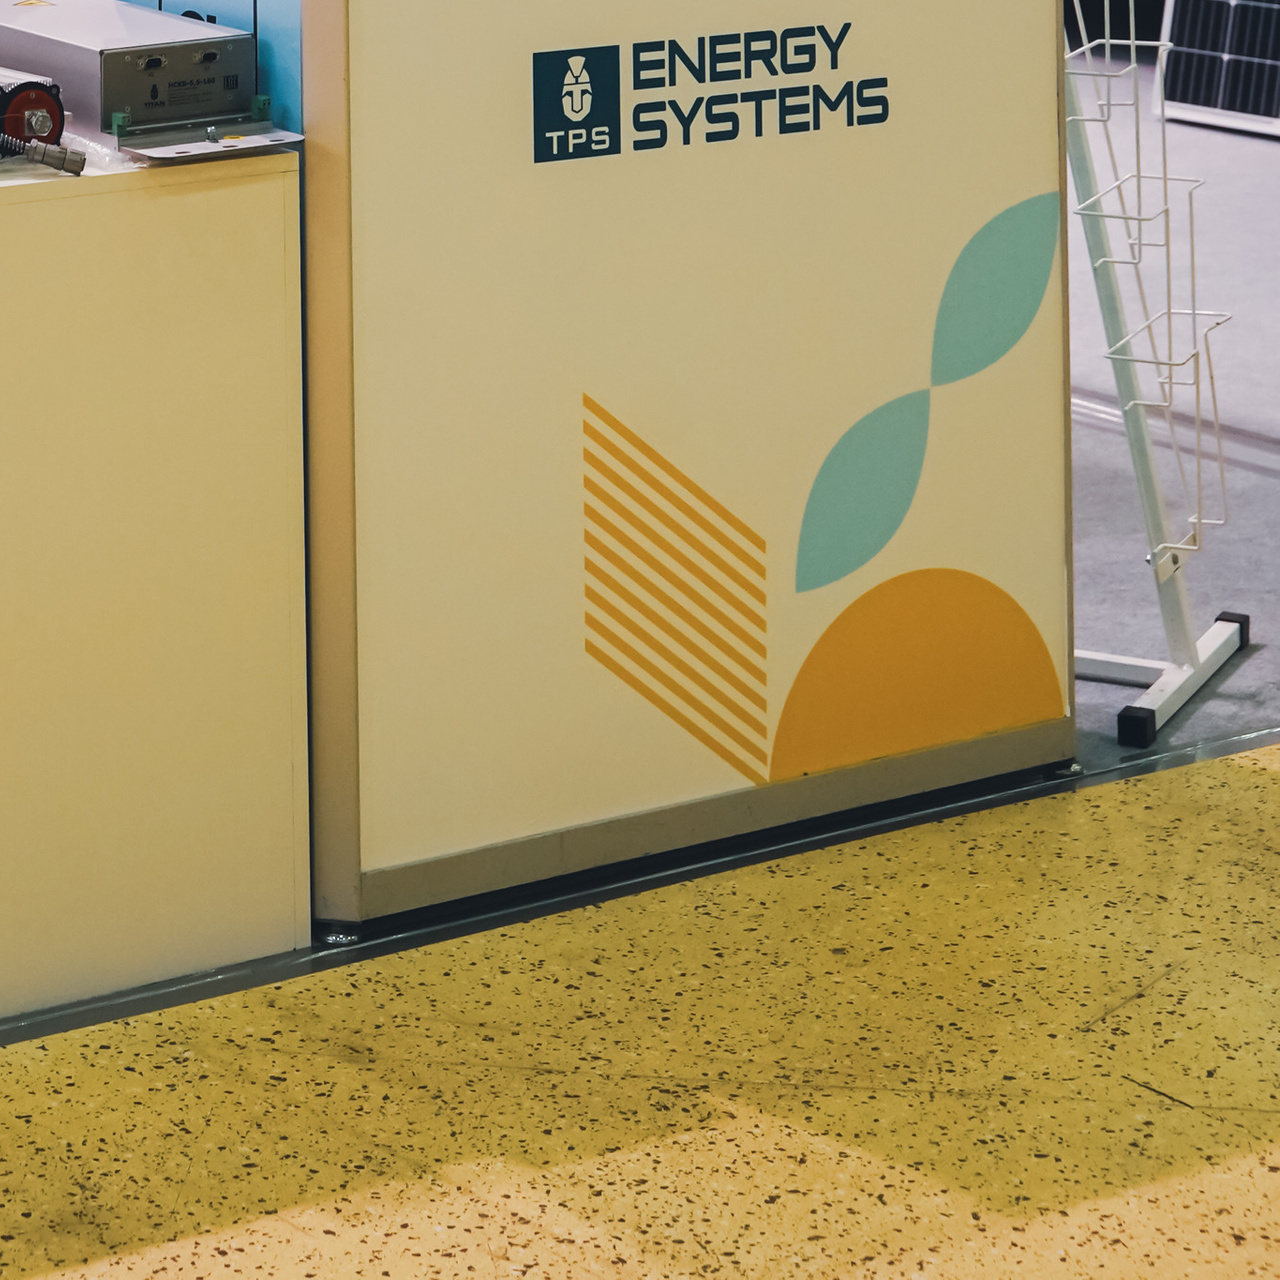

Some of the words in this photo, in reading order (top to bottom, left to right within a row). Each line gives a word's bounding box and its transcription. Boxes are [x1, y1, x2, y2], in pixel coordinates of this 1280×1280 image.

[632, 22, 852, 91] ENERGY
[545, 126, 610, 155] TPS
[631, 77, 889, 151] SYSTEMS
